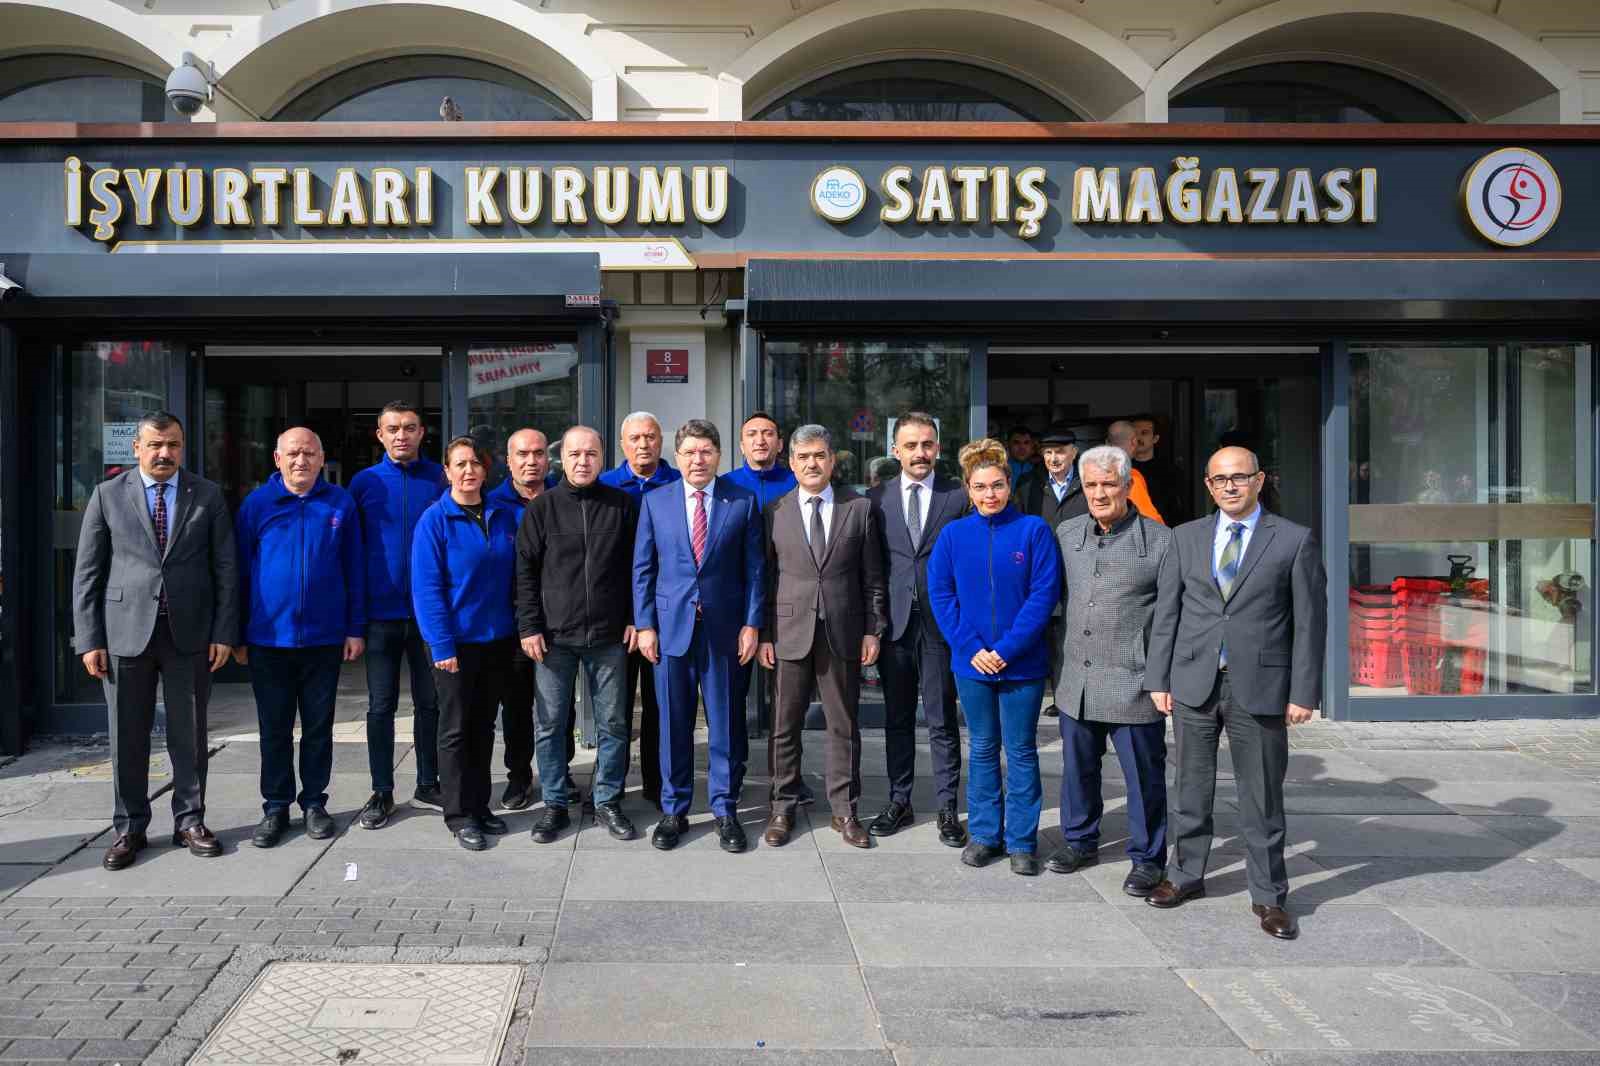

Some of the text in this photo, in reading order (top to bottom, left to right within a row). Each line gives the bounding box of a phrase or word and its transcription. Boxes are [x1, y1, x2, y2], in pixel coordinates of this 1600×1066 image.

[64, 155, 730, 241] İŞYURTLARI KURUMU
[818, 190, 850, 199] ADEKO
[880, 156, 1378, 239] SATIŞ MAĞAZASI
[664, 351, 672, 363] 8
